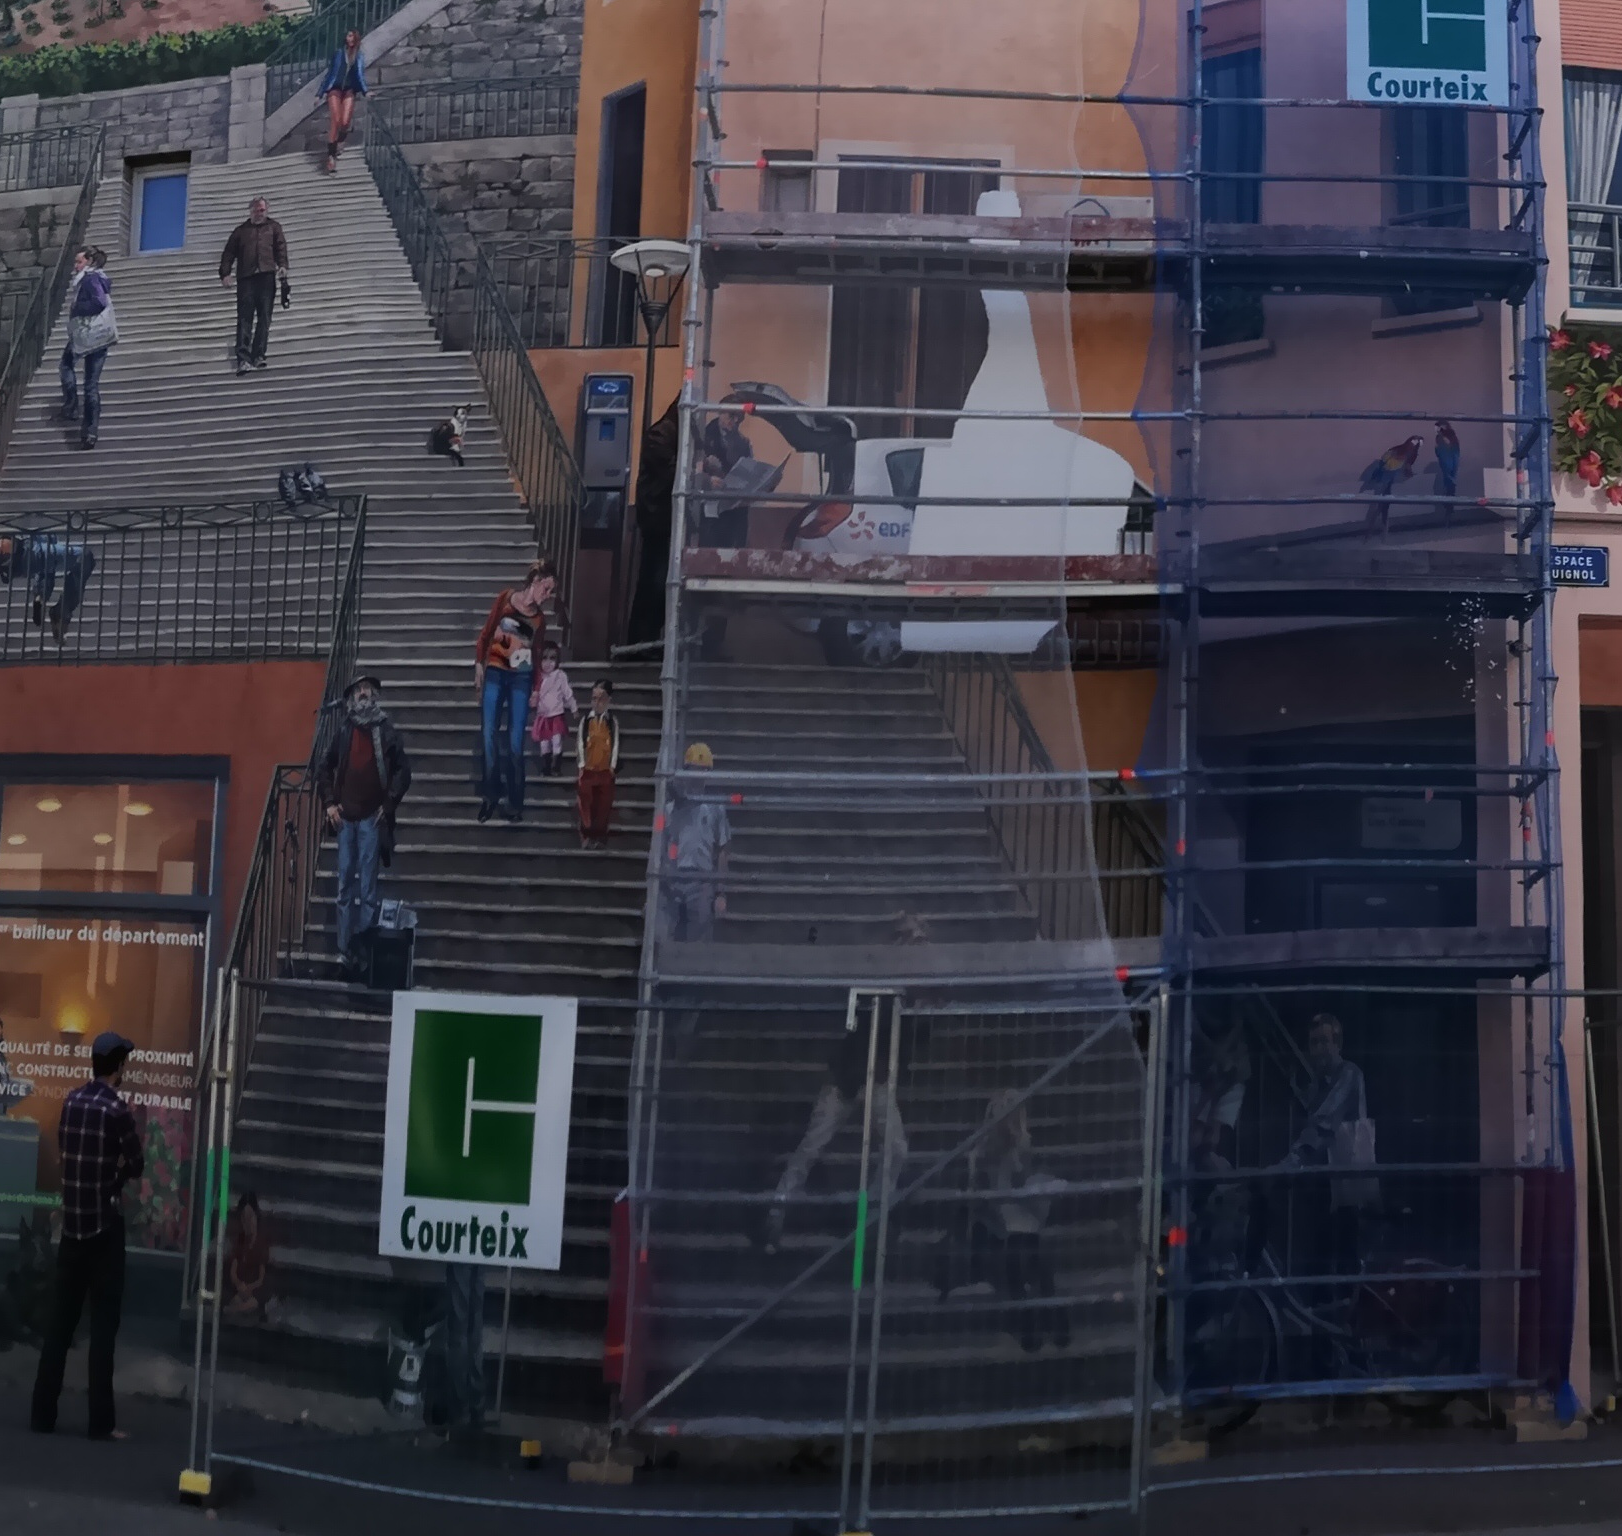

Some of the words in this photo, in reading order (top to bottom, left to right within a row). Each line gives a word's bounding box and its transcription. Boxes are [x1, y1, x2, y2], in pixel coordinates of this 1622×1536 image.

[1367, 71, 1489, 102] Courteix
[1551, 569, 1597, 581] UIGNOL
[12, 923, 73, 940] bailleur
[77, 925, 98, 941] du
[102, 928, 204, 946] département
[0, 1041, 51, 1056] QUALITÉ
[54, 1045, 71, 1056] DE
[128, 1049, 194, 1067] PROXIMITÉ
[133, 1092, 192, 1111] DURABLE
[400, 1205, 529, 1259] Courteix
